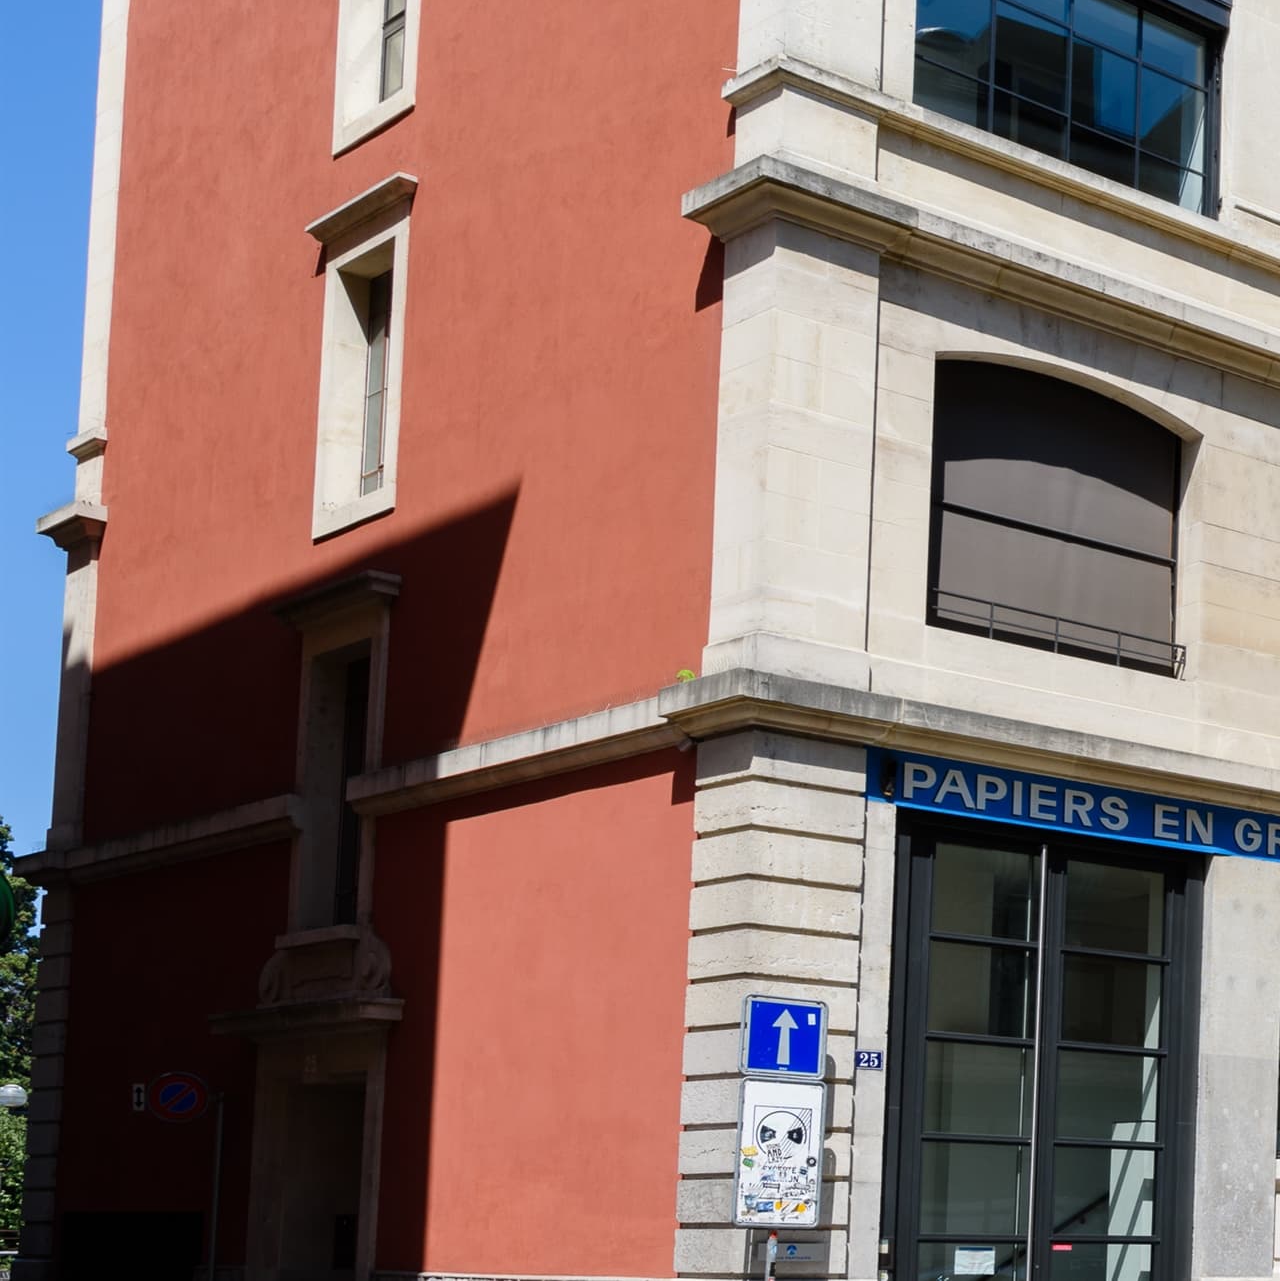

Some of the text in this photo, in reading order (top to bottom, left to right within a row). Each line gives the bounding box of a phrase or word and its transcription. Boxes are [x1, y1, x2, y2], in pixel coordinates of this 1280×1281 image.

[902, 761, 1129, 832] PAPIERS
[1153, 803, 1214, 845] EN
[859, 1051, 879, 1068] 25
